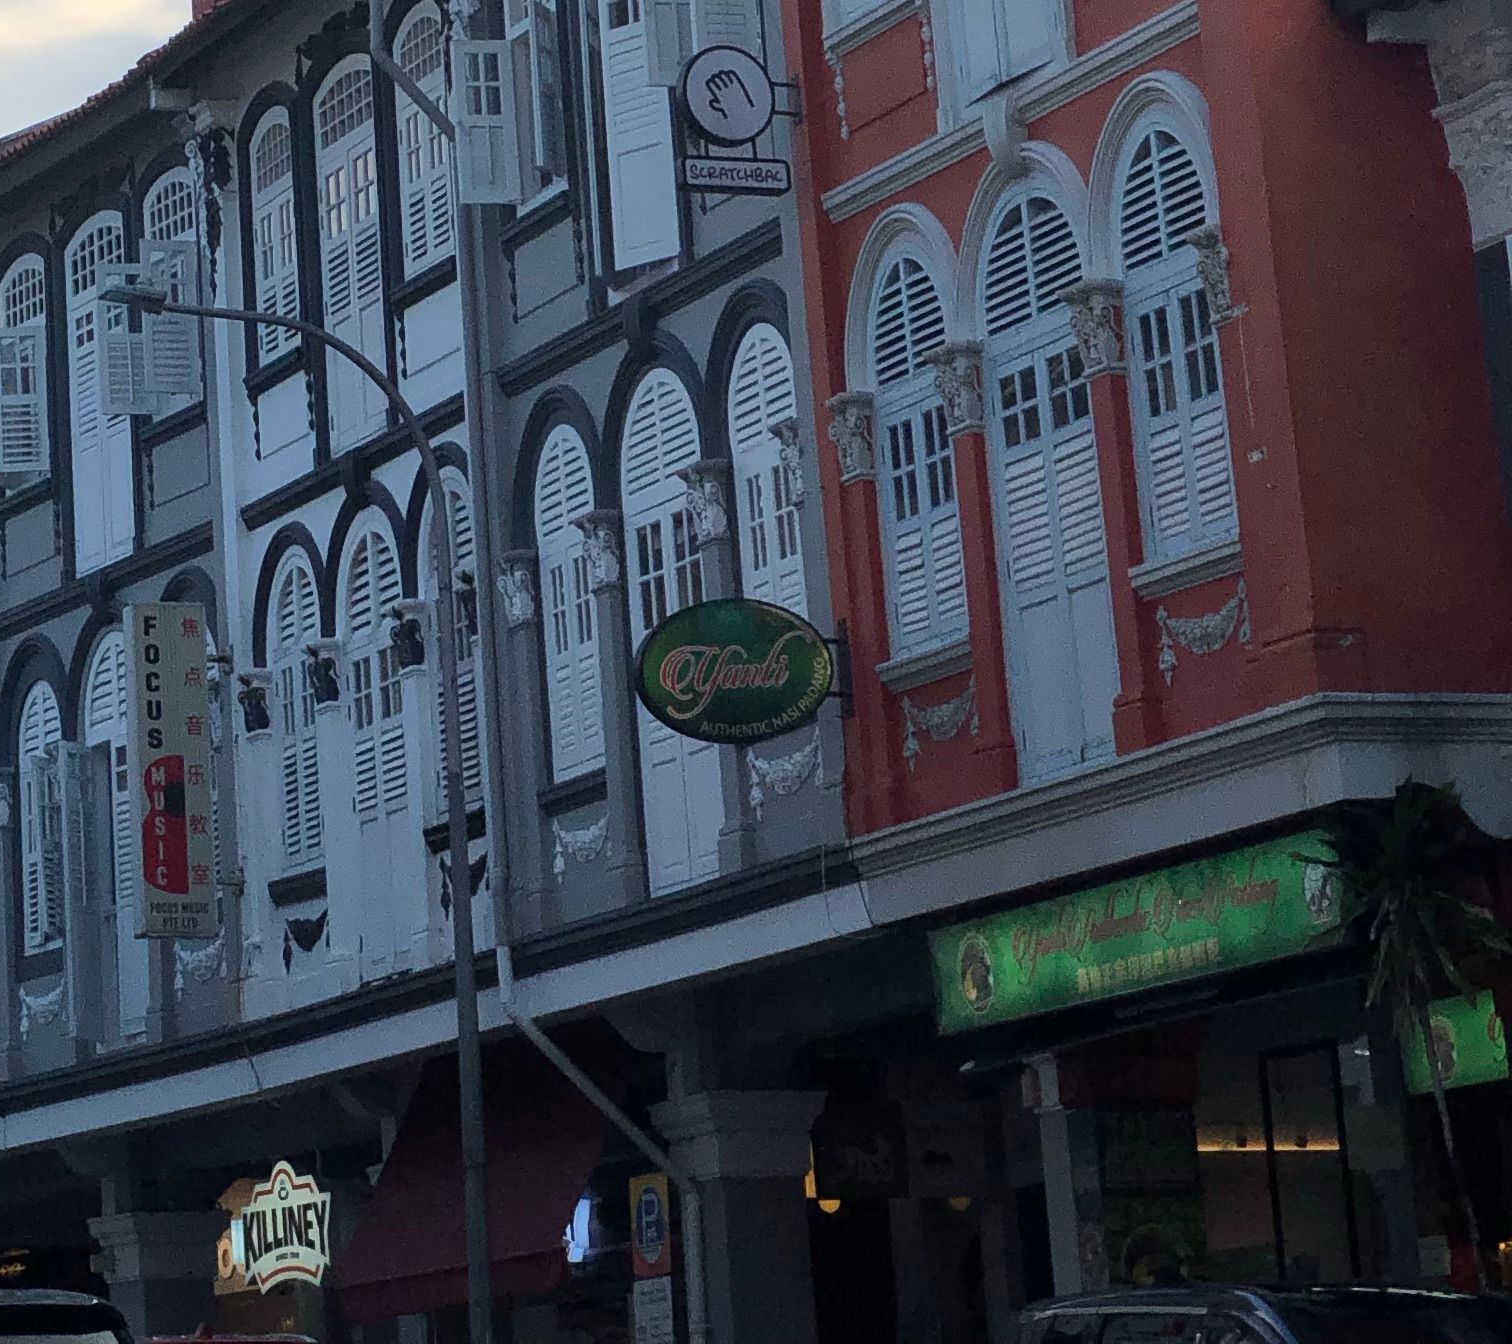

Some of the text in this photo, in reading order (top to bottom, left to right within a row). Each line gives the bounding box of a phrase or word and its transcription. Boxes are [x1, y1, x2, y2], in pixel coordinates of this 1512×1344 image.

[689, 164, 785, 183] SCRATCHBAC
[142, 615, 164, 750] FOCUS
[660, 630, 814, 720] Yanti
[699, 656, 826, 737] AUTHENTIC NASI PADANG
[180, 615, 210, 886] 焦点音乐教室
[150, 765, 168, 887] MUSIC
[149, 902, 209, 915] FOCUS MUSIC
[243, 1200, 327, 1272] KILLINEY
